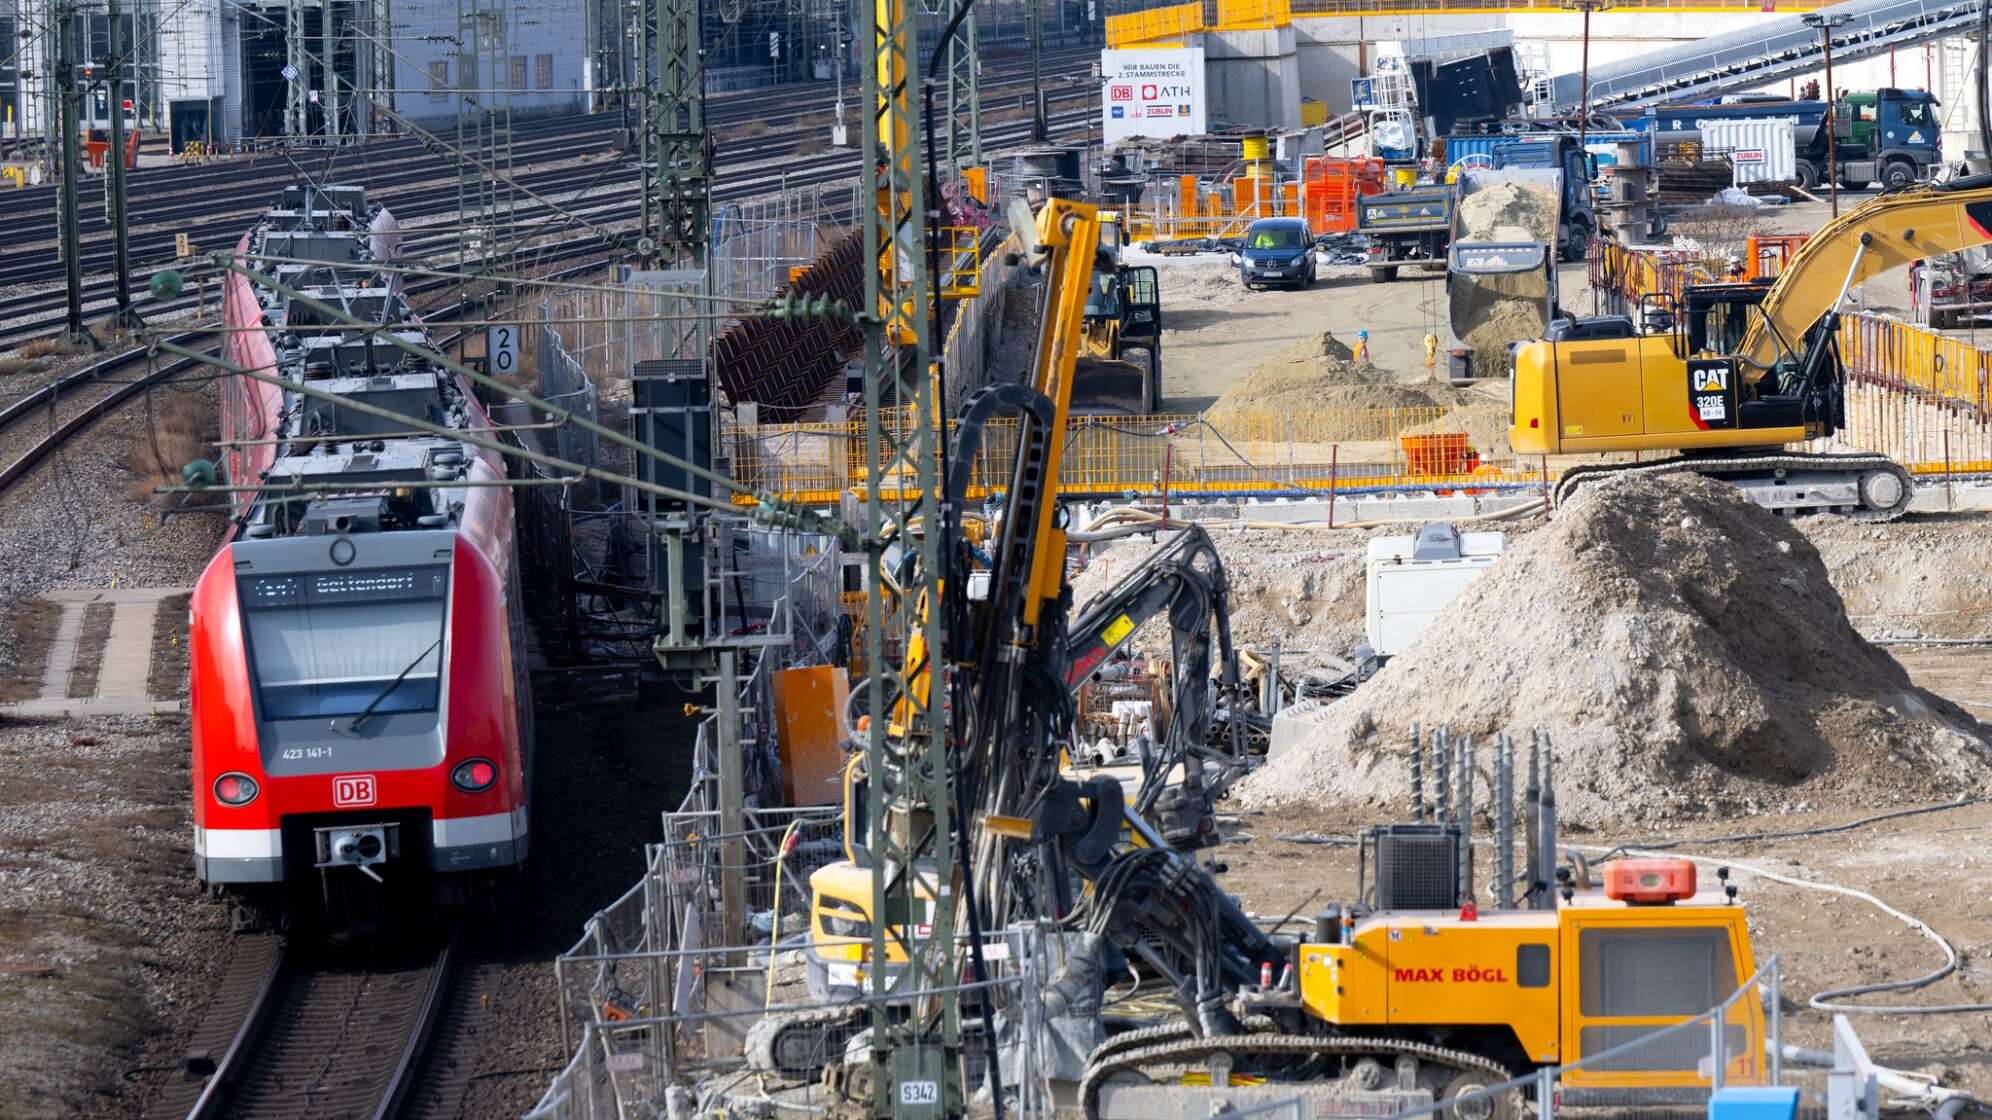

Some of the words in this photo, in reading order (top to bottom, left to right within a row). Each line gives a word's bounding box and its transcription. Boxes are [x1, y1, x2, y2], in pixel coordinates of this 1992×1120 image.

[1112, 86, 1131, 100] DB
[498, 328, 510, 348] 2
[497, 350, 511, 370] 0
[1694, 368, 1729, 391] CAT
[1696, 395, 1724, 408] 320E
[282, 748, 303, 760] 423
[306, 747, 332, 758] 141-1
[336, 778, 373, 804] DB
[1395, 968, 1444, 982] MAX
[1452, 964, 1508, 983] BÖGL
[904, 1084, 935, 1100] S342
